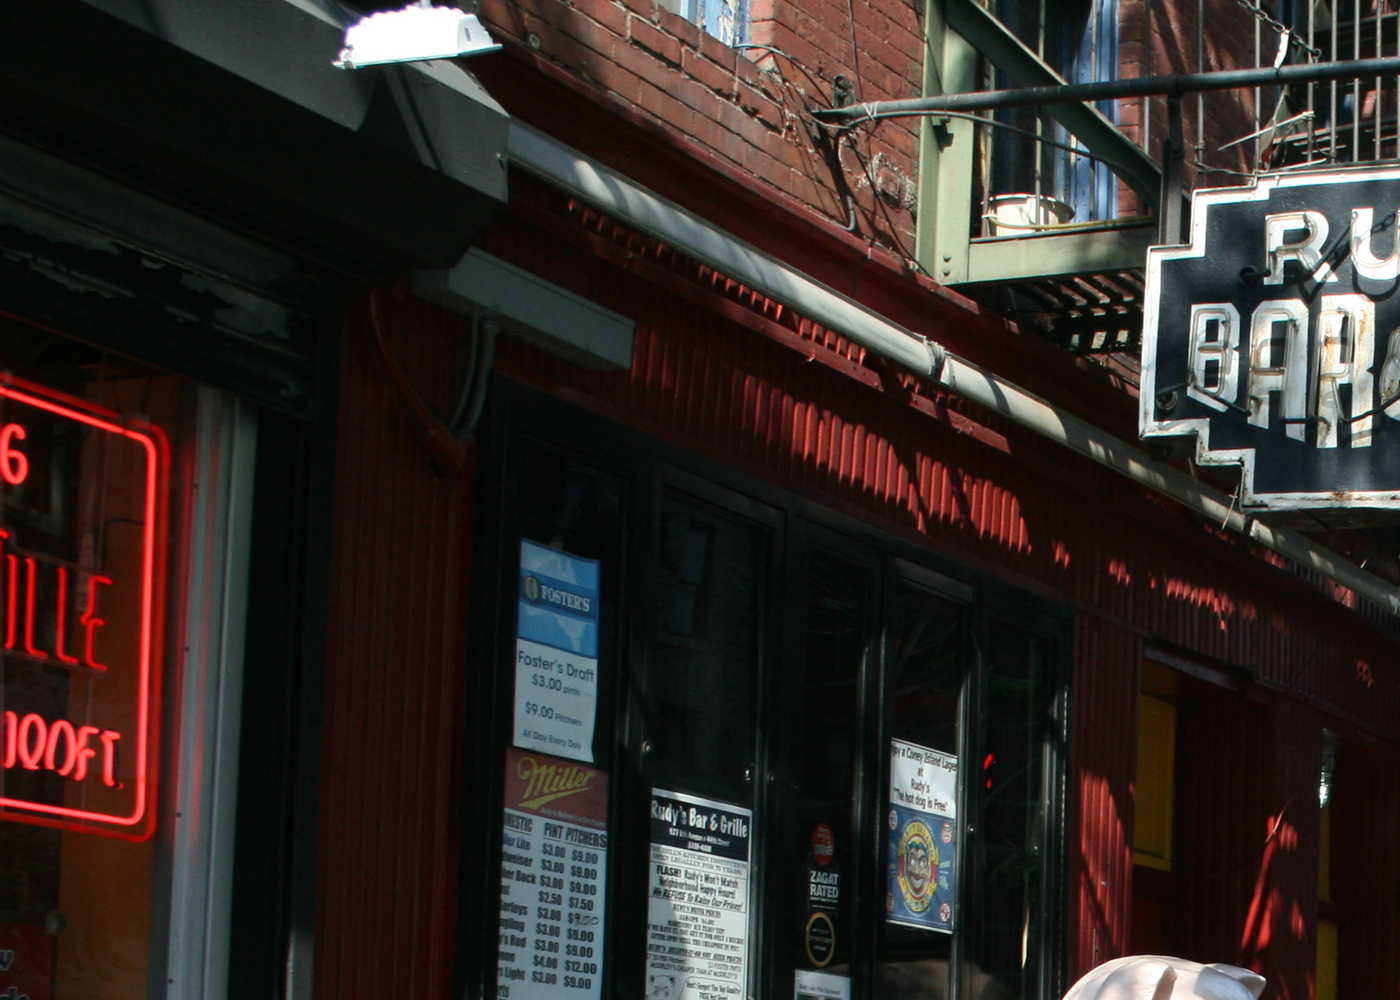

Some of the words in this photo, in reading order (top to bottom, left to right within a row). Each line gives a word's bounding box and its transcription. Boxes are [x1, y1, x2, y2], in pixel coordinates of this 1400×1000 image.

[1186, 294, 1376, 448] BAR
[541, 585, 591, 612] FOSTER'S
[518, 650, 563, 674] Foster's
[566, 663, 595, 682] Draft
[531, 673, 562, 691] $3.00
[525, 701, 554, 719] $9.00
[518, 756, 594, 800] Miller
[651, 800, 687, 826] Rudy's
[689, 808, 707, 829] Bar
[710, 814, 718, 831] &
[720, 816, 748, 838] Grille
[810, 870, 840, 885] ZAGAT
[810, 884, 840, 897] RATED
[565, 960, 597, 975] $12.00
